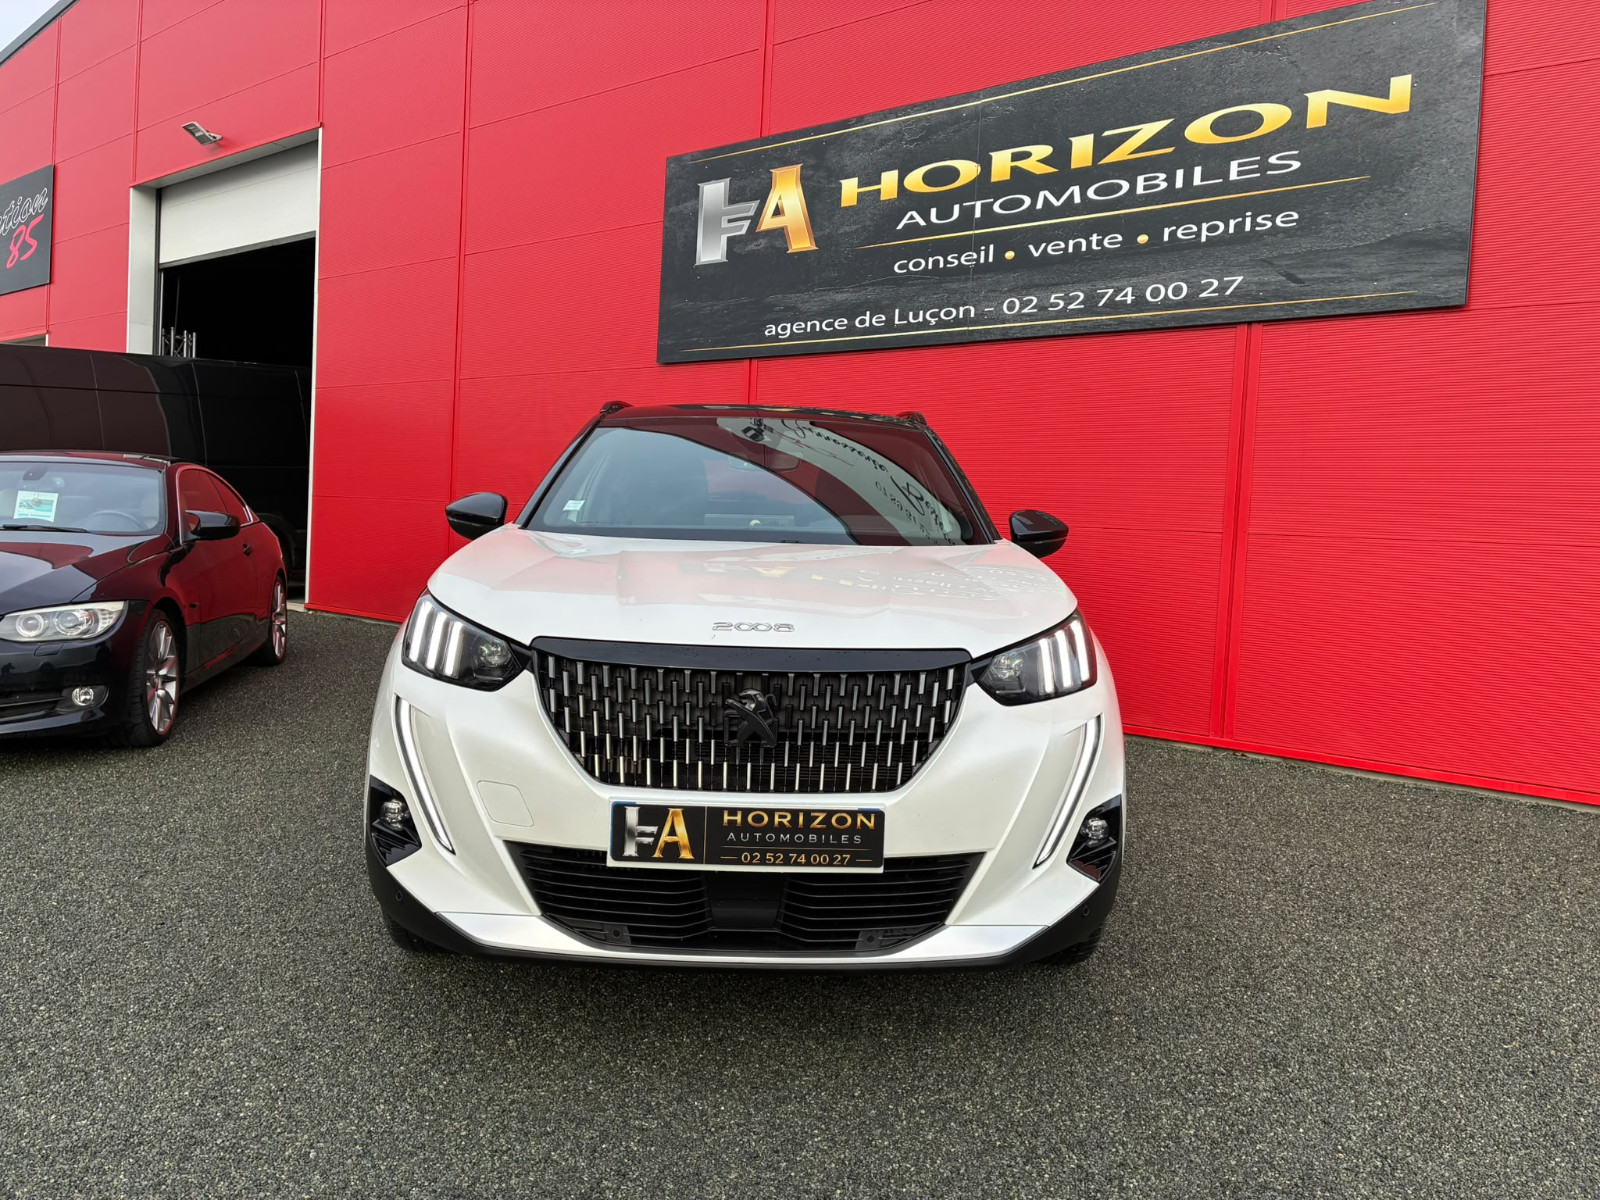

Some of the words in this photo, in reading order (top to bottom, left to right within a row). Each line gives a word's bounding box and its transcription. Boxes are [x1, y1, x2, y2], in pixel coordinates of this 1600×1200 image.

[839, 74, 1412, 208] HORIZON
[896, 150, 1302, 230] AUTOMOBILES
[6, 213, 44, 269] 85
[893, 244, 994, 273] conseil
[1028, 232, 1123, 257] vente
[1162, 211, 1300, 242] reprise
[764, 317, 848, 339] agence
[855, 311, 886, 328] de
[895, 304, 975, 326] Luçon
[1002, 295, 1038, 315] 02
[1048, 291, 1085, 311] 52
[1096, 287, 1136, 307] 74
[1145, 281, 1188, 302] 00
[1198, 276, 1244, 298] 27
[712, 621, 795, 633] 2008
[722, 810, 876, 830] HORIZON
[727, 832, 863, 844] AUTOMOBILES
[741, 852, 760, 864] 02
[765, 853, 784, 864] 52
[788, 853, 807, 865] 74
[811, 854, 829, 865] 00
[832, 854, 851, 866] 27
